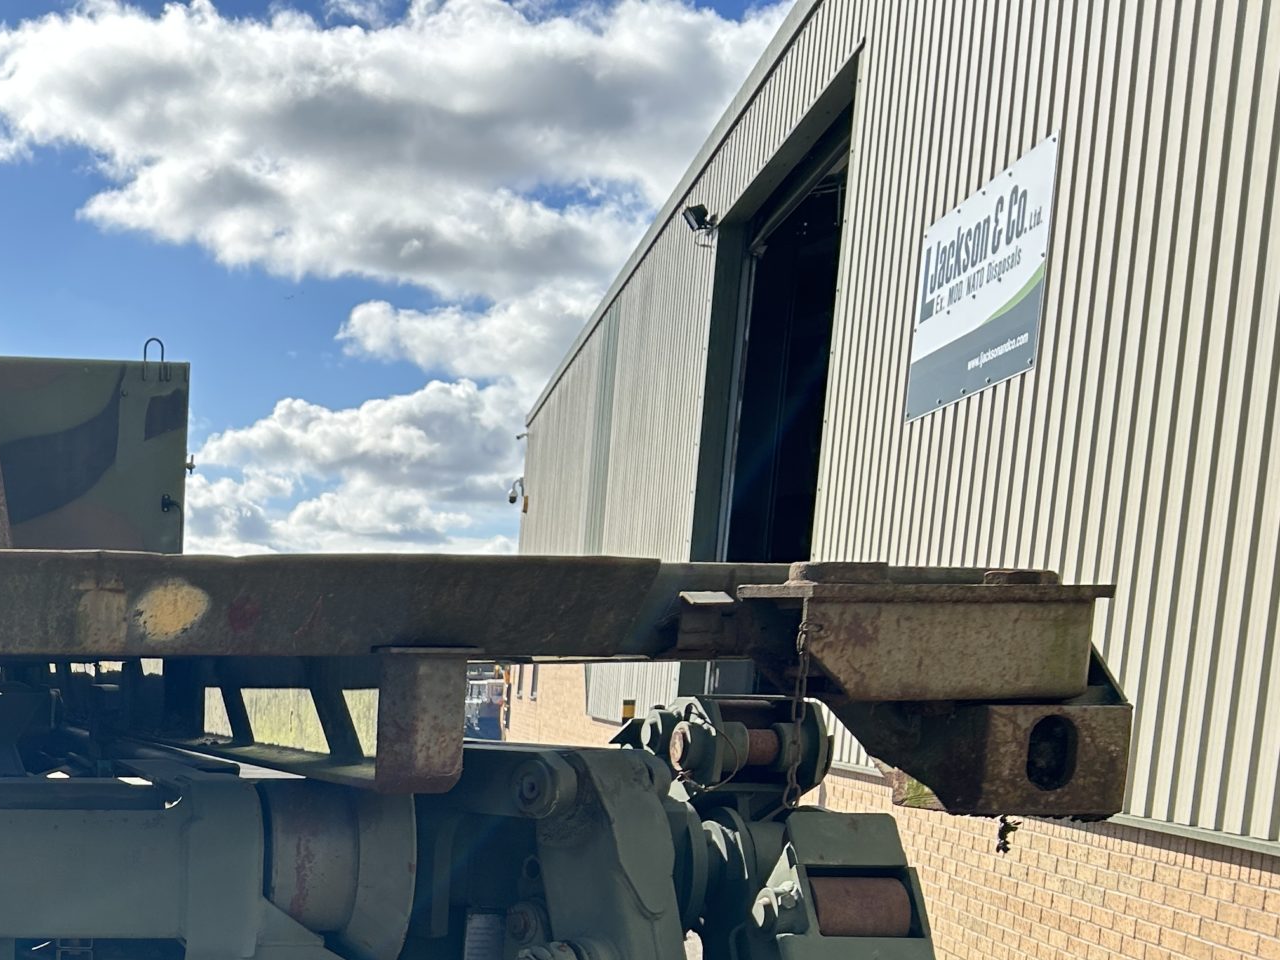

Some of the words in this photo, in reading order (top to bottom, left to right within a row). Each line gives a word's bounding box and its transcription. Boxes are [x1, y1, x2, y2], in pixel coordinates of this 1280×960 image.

[991, 195, 1005, 255] &
[1005, 184, 1028, 246] Co.
[1028, 205, 1043, 231] Ltd.
[947, 280, 964, 308] MOD
[966, 266, 985, 297] NATO
[986, 245, 1022, 284] Disposals
